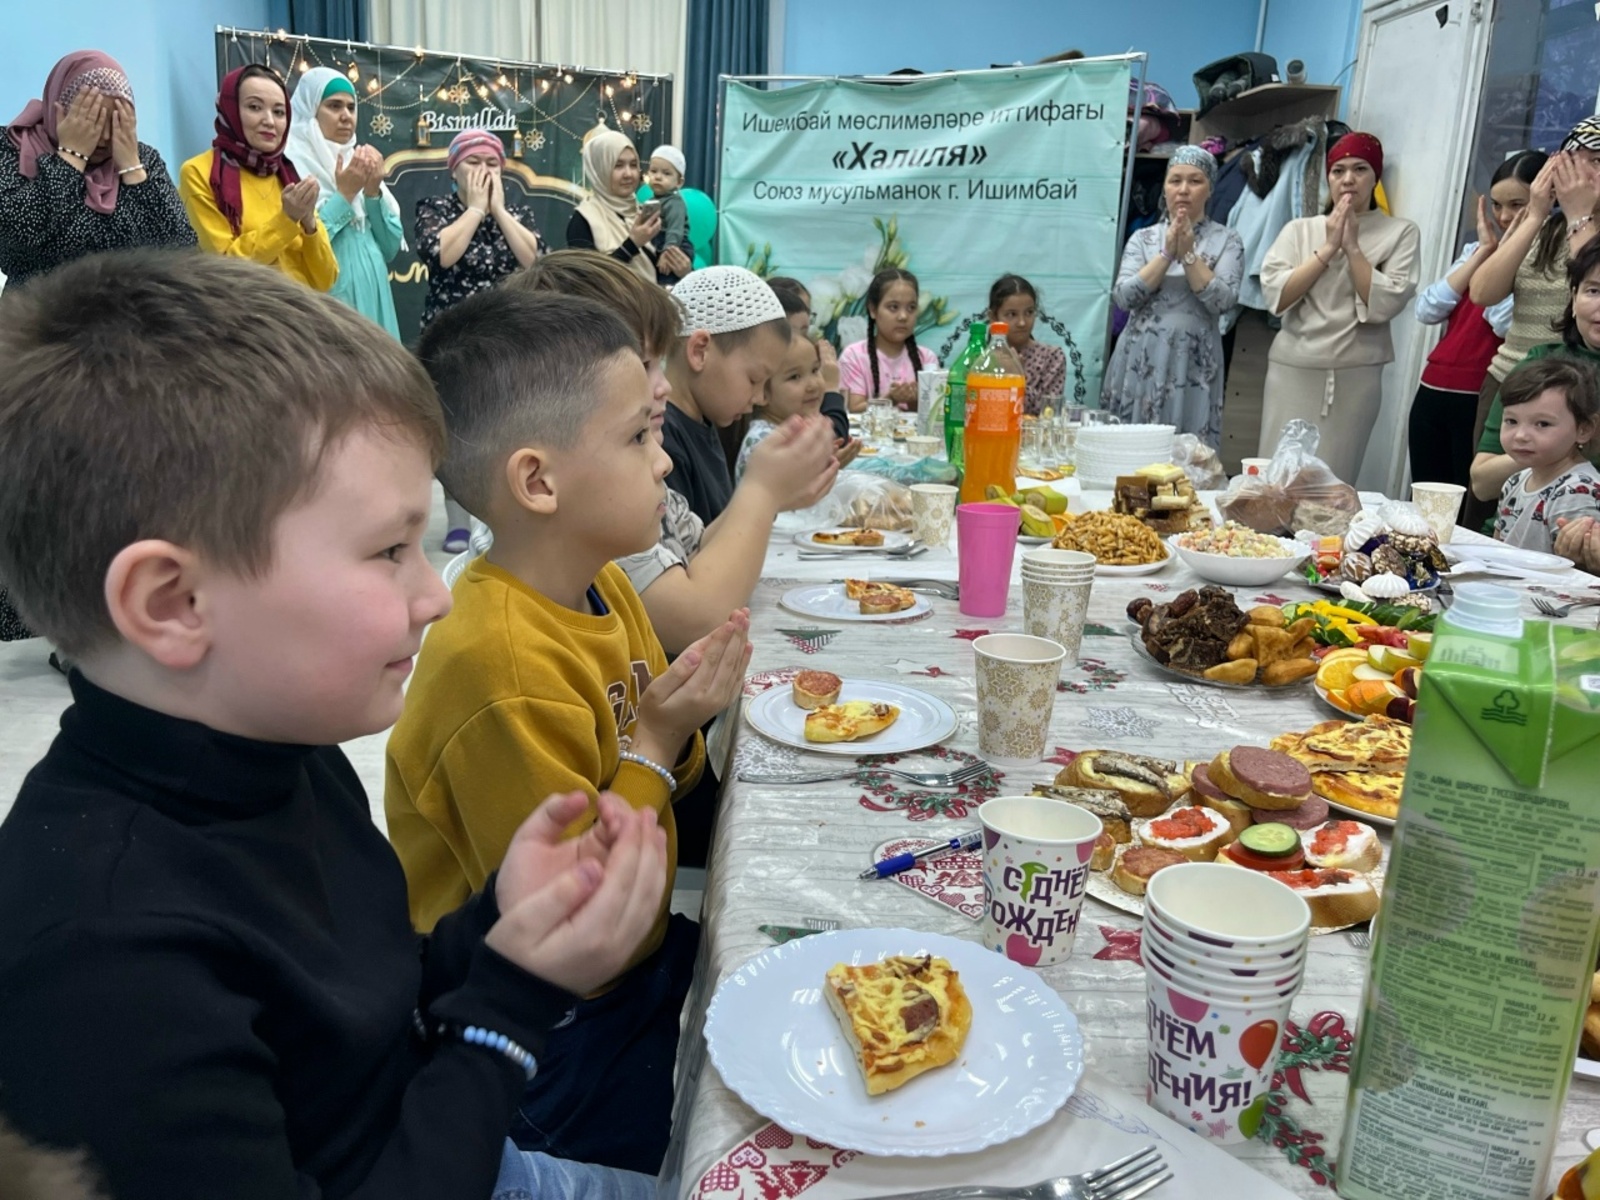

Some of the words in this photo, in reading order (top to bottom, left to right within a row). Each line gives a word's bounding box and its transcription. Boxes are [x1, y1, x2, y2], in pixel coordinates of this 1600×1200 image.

[422, 107, 518, 131] Bismillah
[743, 110, 831, 133] Ишембай
[838, 111, 985, 132] мөслимәләре
[990, 99, 1105, 126] иттифағы
[832, 141, 988, 170] «Халиля»
[754, 181, 803, 200] Союз
[808, 184, 941, 205] мусульманок
[949, 184, 959, 200] г.
[968, 178, 1077, 200] Ишимбай
[985, 882, 1082, 947] РОЖДЕН
